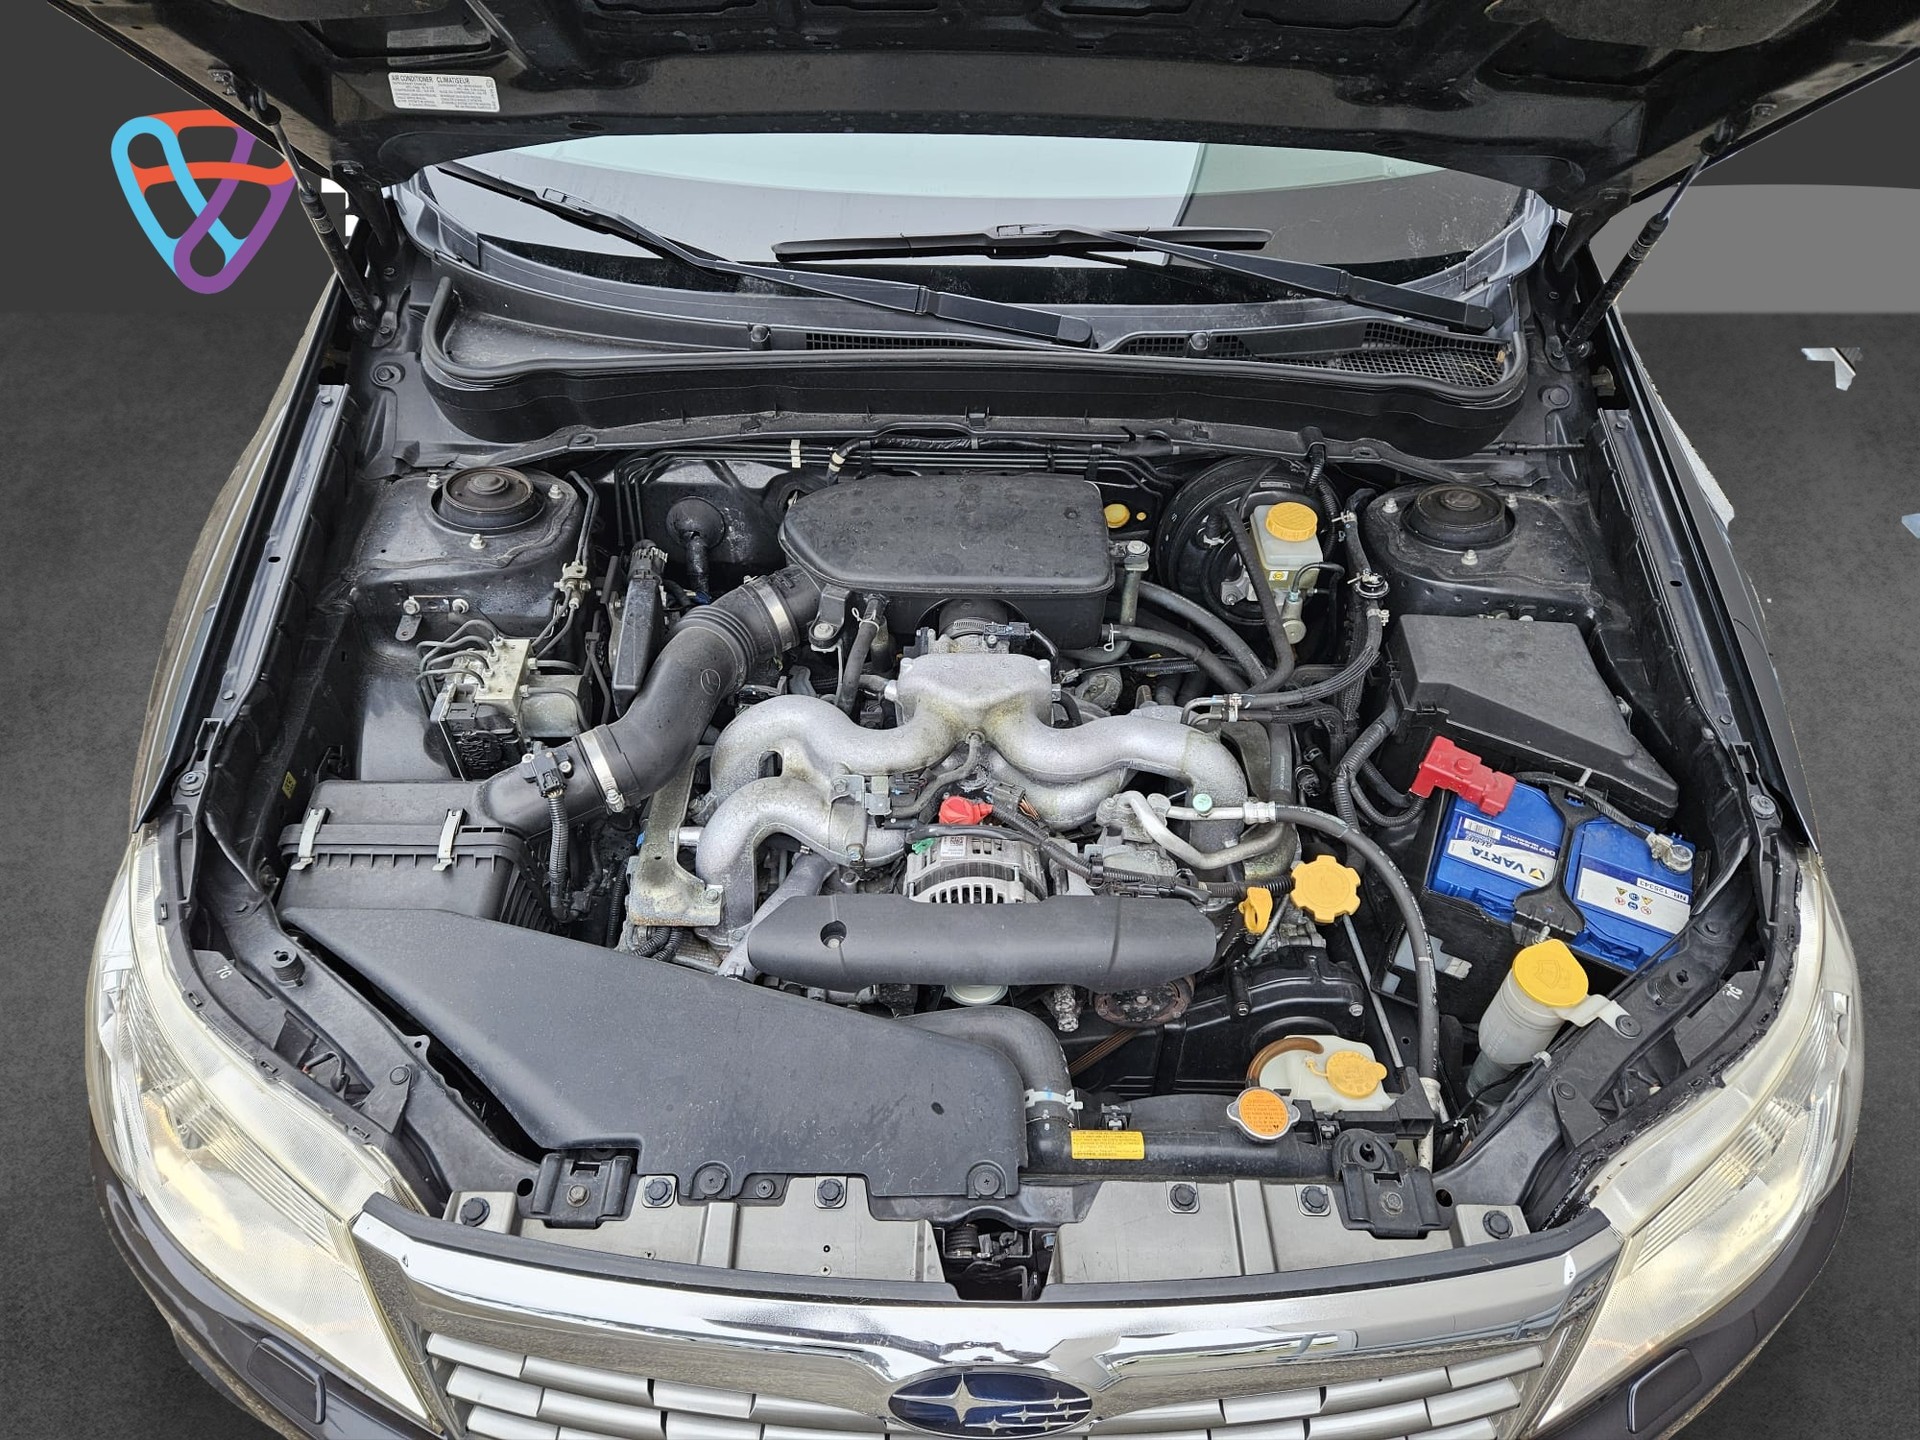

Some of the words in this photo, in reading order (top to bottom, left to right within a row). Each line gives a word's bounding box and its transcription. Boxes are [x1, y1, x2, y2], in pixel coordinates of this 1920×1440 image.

[400, 75, 433, 83] CONDITIONER
[436, 76, 470, 84] CLIMATISEUR
[1471, 846, 1525, 874] VARTA
